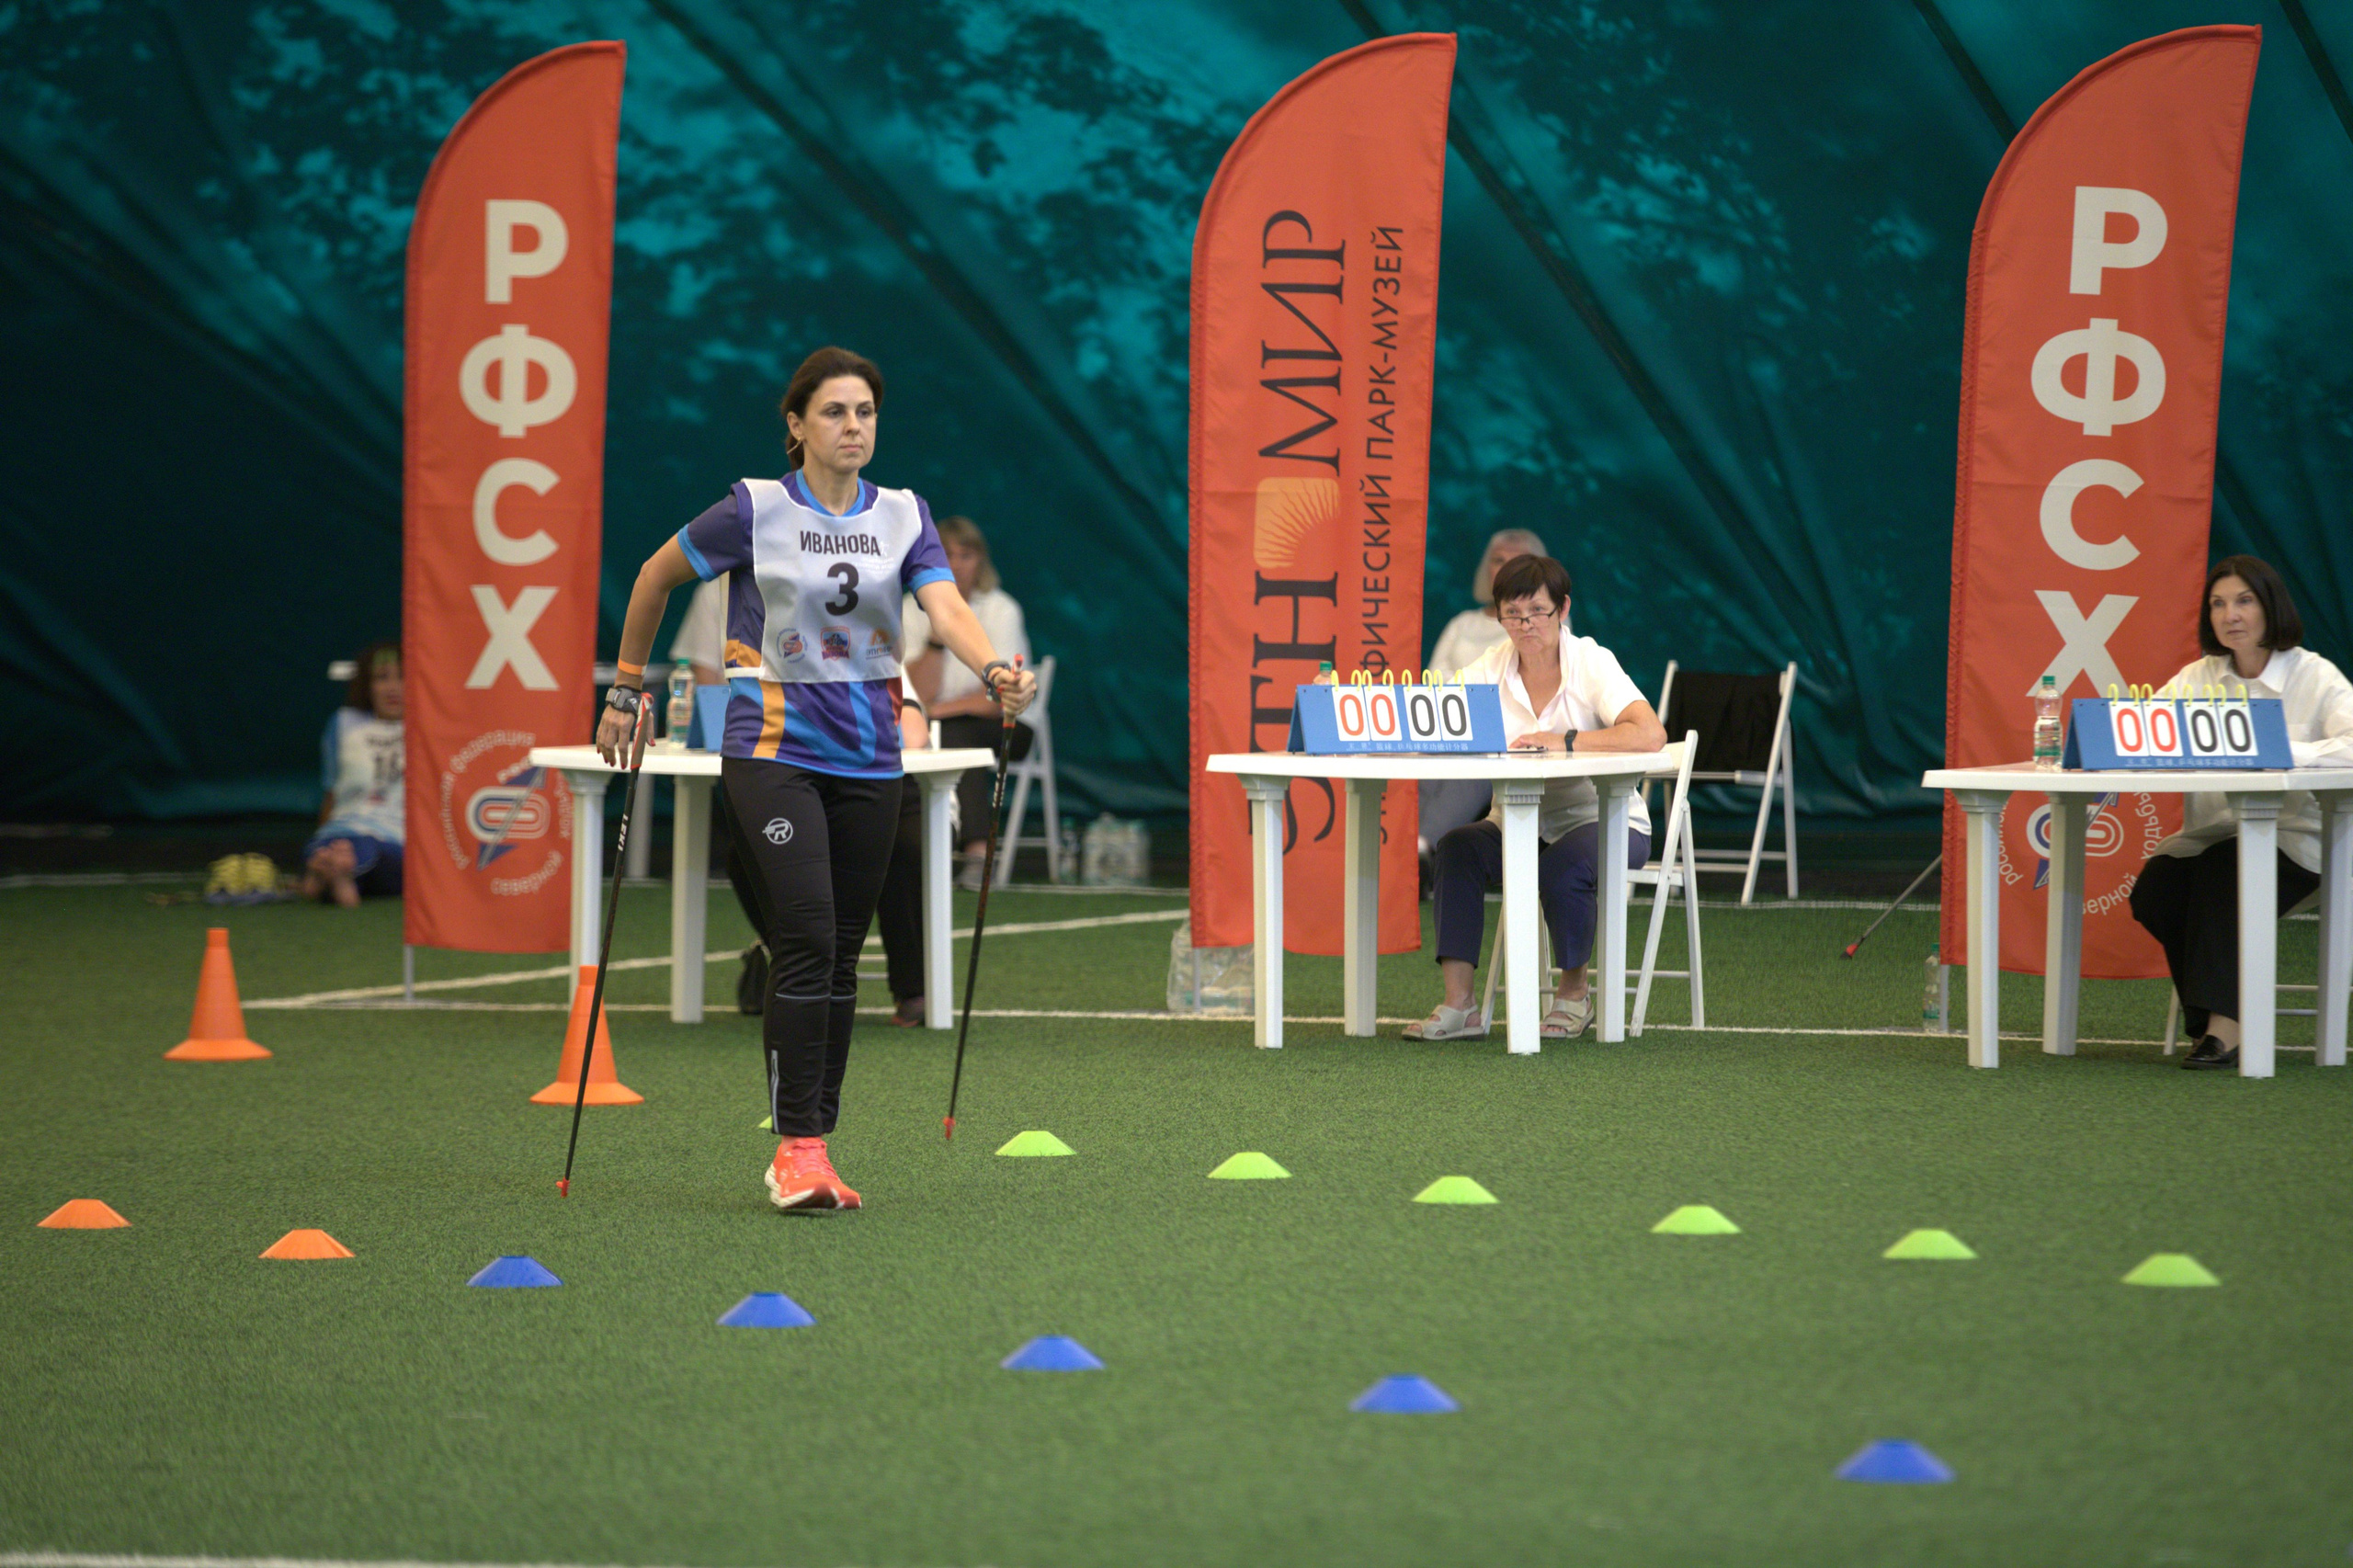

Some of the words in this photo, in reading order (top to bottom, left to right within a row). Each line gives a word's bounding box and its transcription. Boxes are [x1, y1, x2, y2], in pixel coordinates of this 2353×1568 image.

[1366, 226, 1404, 460] ПАРК-МУЗЕЙ
[459, 199, 578, 691] РФСХ
[2025, 186, 2168, 699] РФСХ
[800, 530, 881, 557] ИВАНОВА
[824, 562, 859, 616] 3
[1358, 473, 1392, 683] ФИЧЕСКИЙ
[617, 812, 630, 852] LEKI
[2082, 871, 2139, 916] ерной
